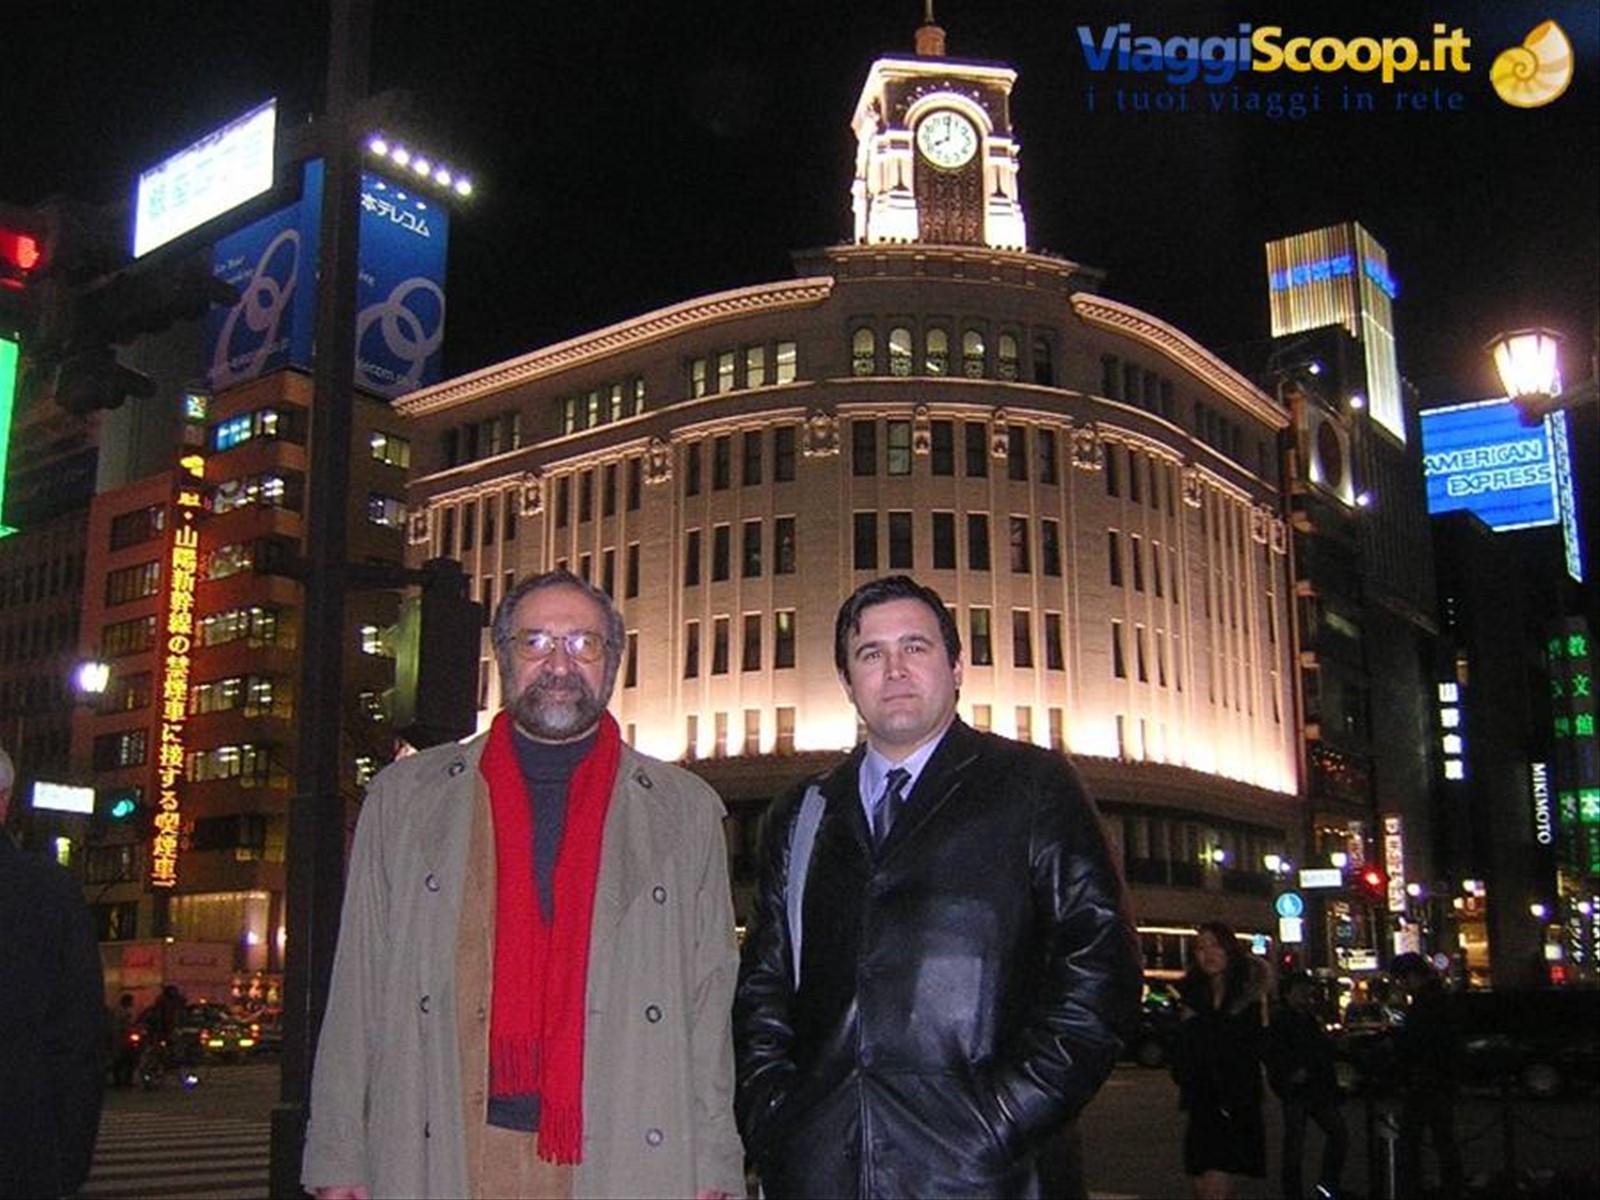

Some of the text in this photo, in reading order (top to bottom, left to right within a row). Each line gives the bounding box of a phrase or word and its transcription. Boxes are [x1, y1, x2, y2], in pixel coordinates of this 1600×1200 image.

[1423, 440, 1543, 476] AMERICAN
[1448, 465, 1552, 497] EXPRESS
[1532, 763, 1551, 844] MIKIMOTO
